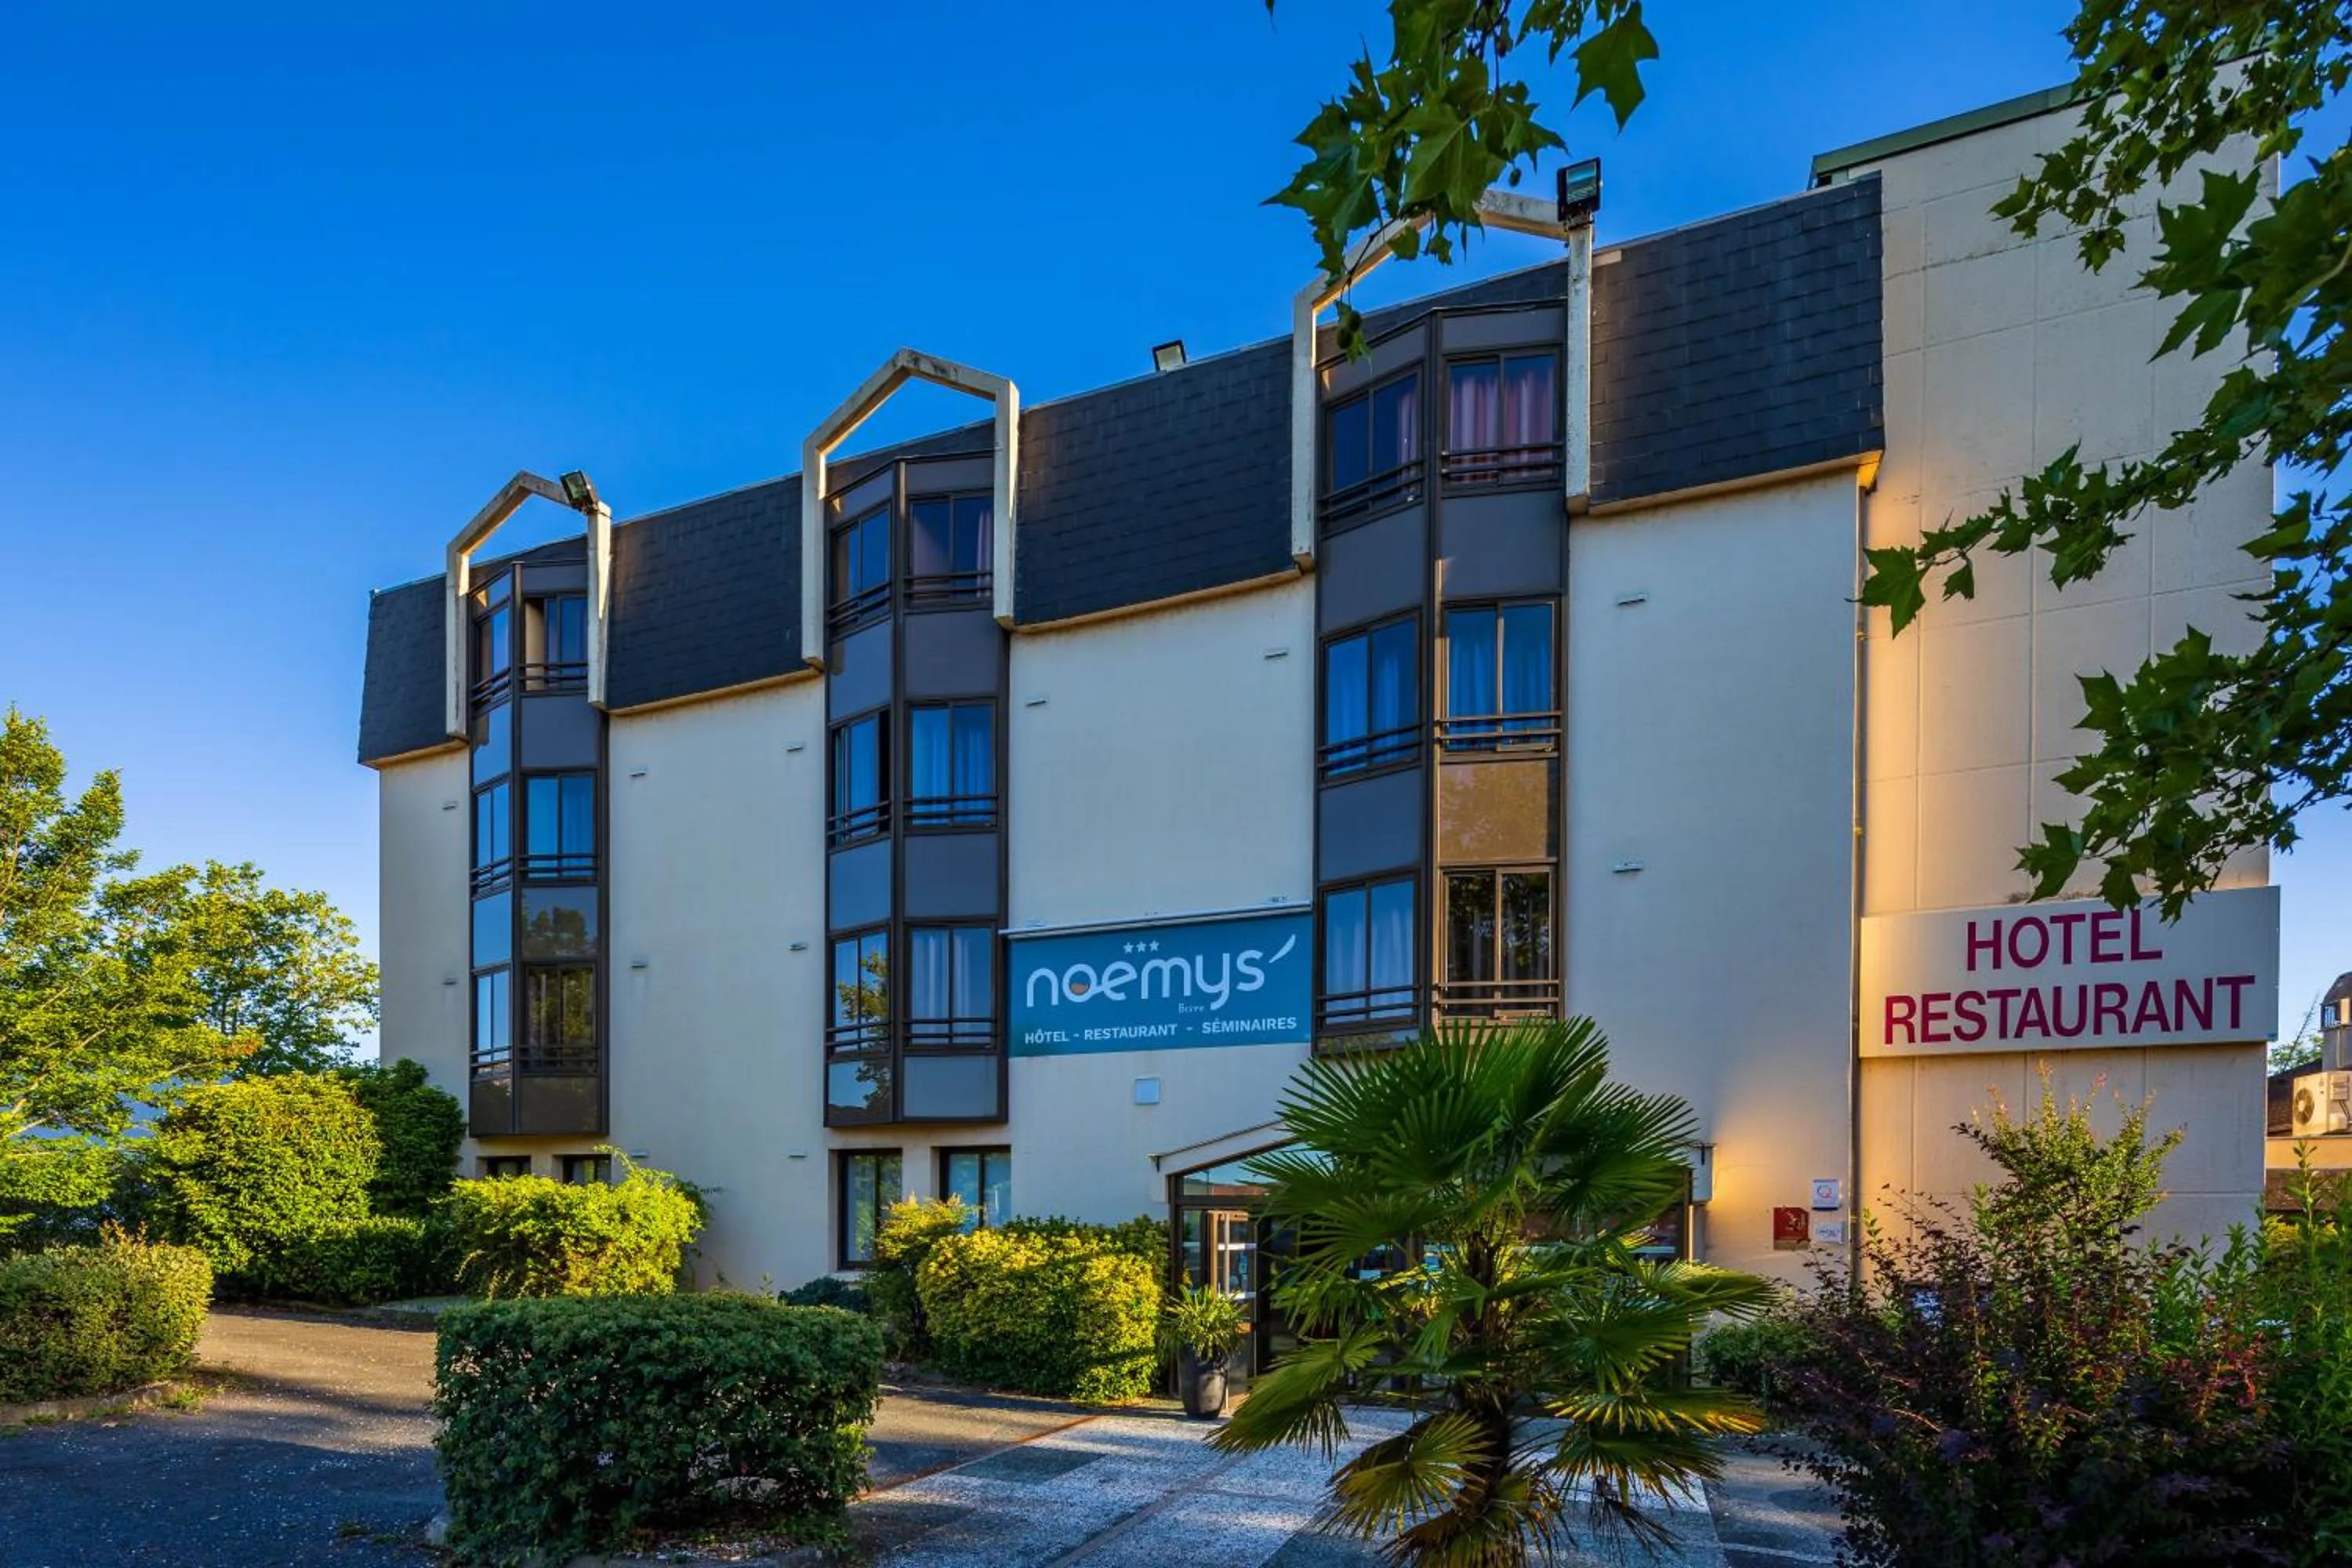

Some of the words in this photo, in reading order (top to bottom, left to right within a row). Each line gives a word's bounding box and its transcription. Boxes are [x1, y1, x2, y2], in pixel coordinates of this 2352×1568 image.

[1966, 908, 2163, 971] HOTEL
[1025, 1028, 1069, 1044] HÔTEL
[1084, 1023, 1178, 1040] RESTAURANT
[1201, 1016, 1297, 1034] SÉMINAIRES
[1884, 975, 2256, 1045] RESTAURANT
